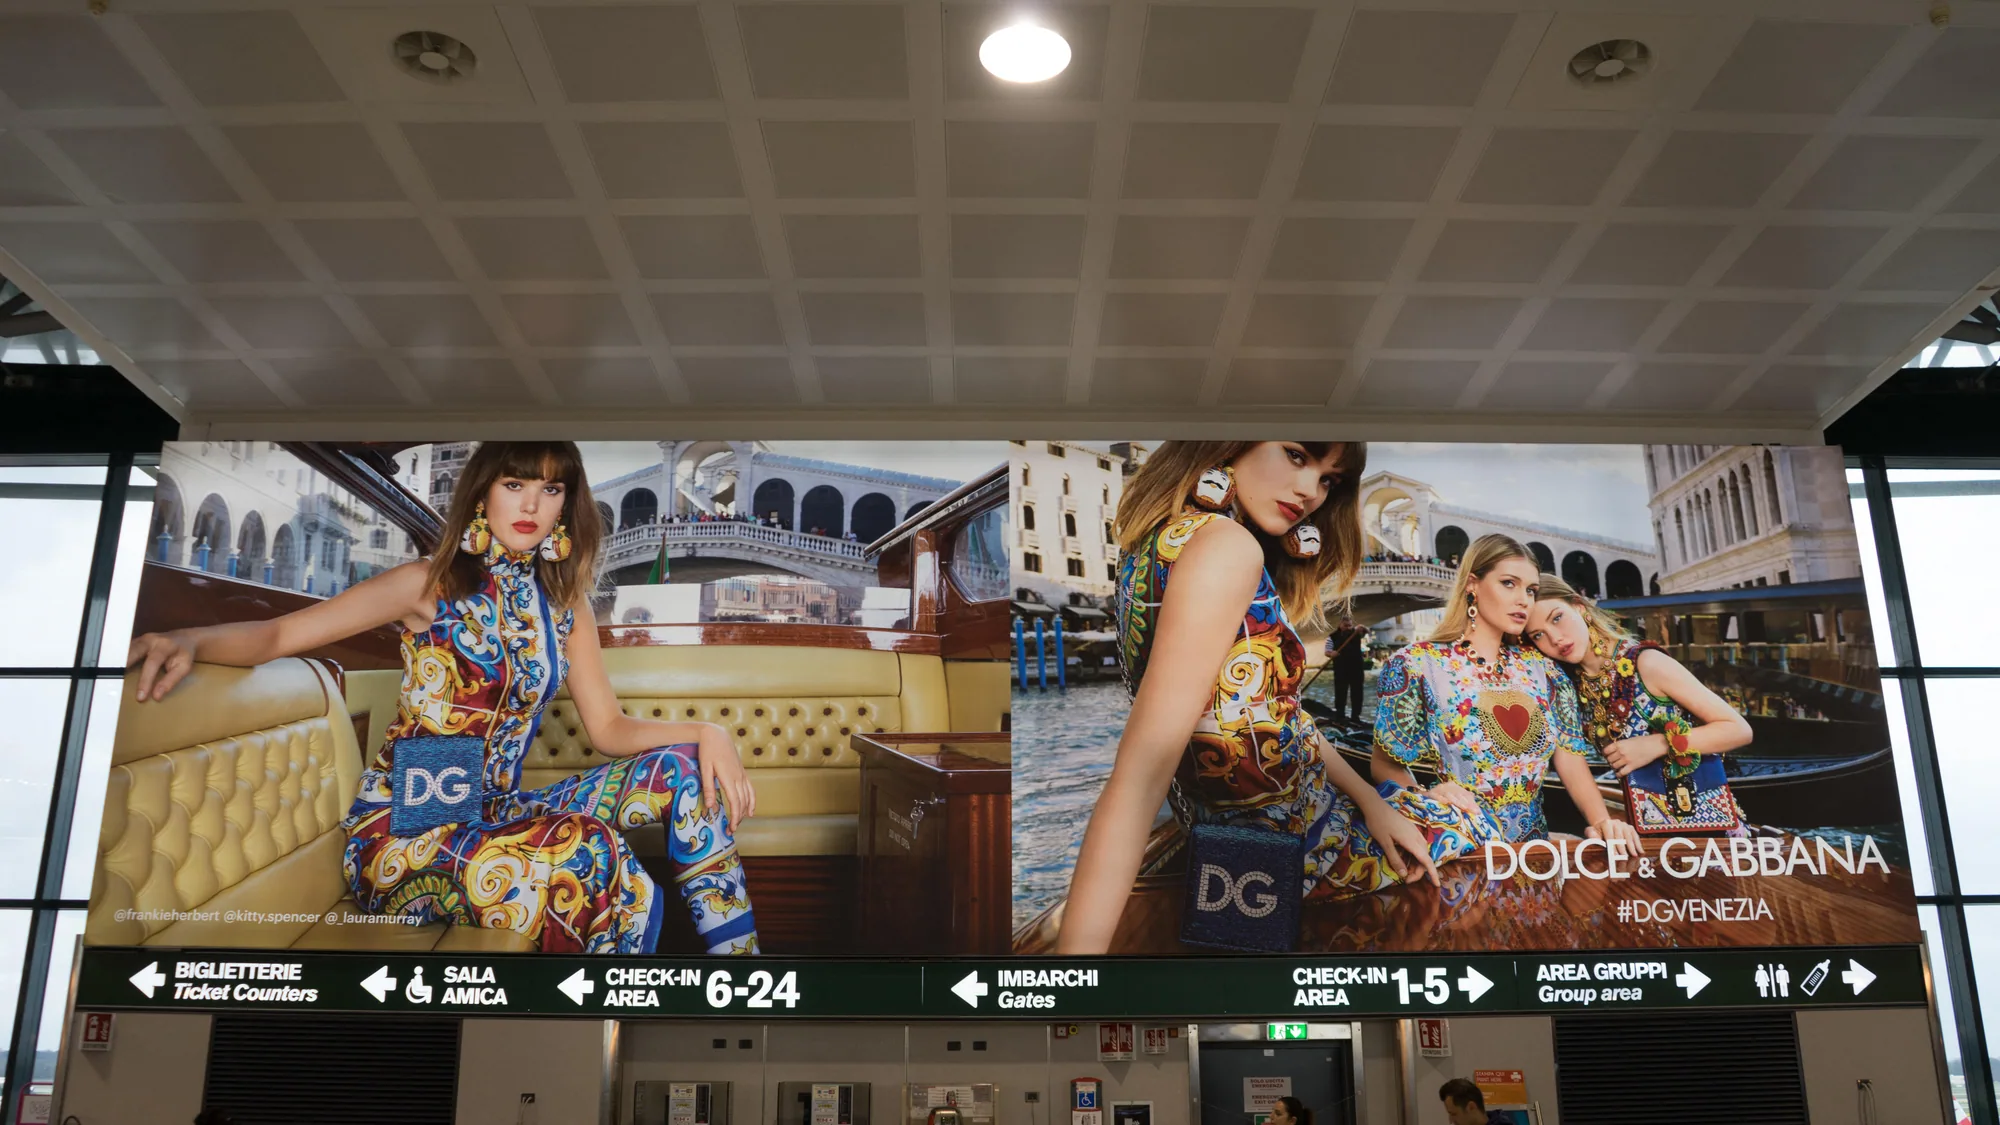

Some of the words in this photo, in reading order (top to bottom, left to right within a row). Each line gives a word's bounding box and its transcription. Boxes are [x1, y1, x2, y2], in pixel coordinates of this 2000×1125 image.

[404, 766, 471, 806] DG
[1485, 838, 1631, 881] DOLCE
[1638, 856, 1657, 878] &
[1660, 834, 1891, 879] GABBANA
[1197, 863, 1278, 918] DG
[113, 908, 220, 922] @frankieherbert
[224, 910, 321, 924] @kitty.spencer
[1617, 897, 1774, 923] #DGVENEZIA
[174, 961, 303, 981] BIGLIETTERIE
[443, 965, 497, 984] SALA
[605, 967, 701, 987] CHECK-IN
[997, 968, 1099, 988] IMBARCHI
[1292, 966, 1388, 986] CHECK-IN
[1536, 963, 1592, 982] AREA
[1593, 962, 1668, 981] GRUPPI
[173, 983, 231, 1001] Ticket
[233, 983, 319, 1003] Counters
[705, 969, 801, 1009] 6-24
[1391, 967, 1450, 1005] 1-5
[1538, 984, 1597, 1006] Group
[1600, 986, 1643, 1002] area
[440, 987, 508, 1006] AMICA
[603, 989, 660, 1007] AREA
[997, 990, 1056, 1009] Gates
[1293, 988, 1350, 1006] AREA
